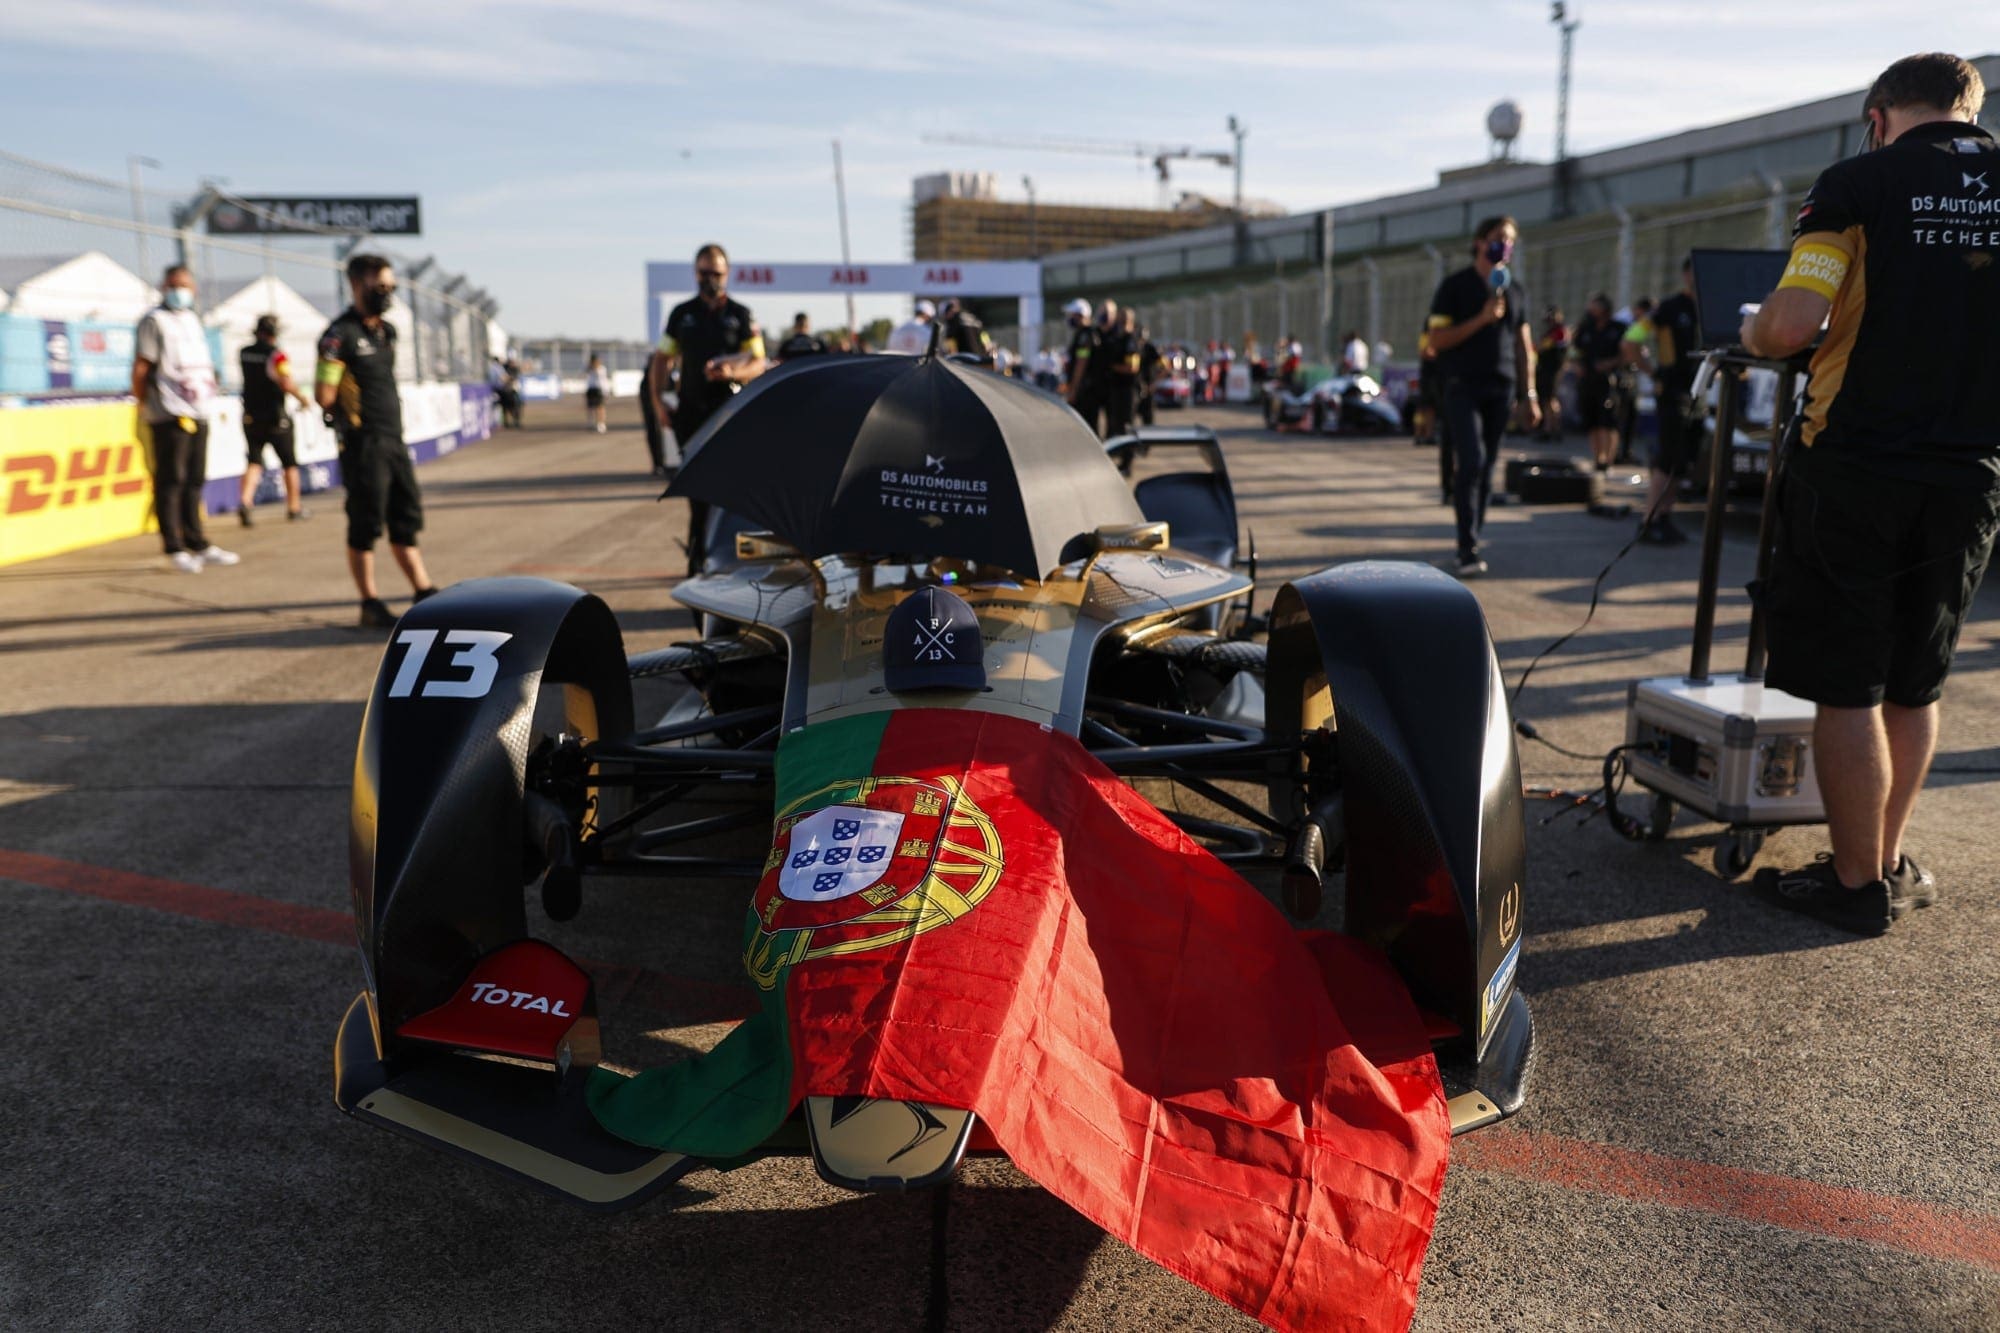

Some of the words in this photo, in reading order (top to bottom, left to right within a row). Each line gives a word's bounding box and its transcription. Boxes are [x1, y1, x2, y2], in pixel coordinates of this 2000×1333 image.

[1911, 196, 1934, 212] DS
[735, 266, 775, 284] ABB
[830, 266, 869, 284] ABB
[924, 266, 962, 284] ABB
[4, 445, 143, 515] DHL
[881, 470, 898, 483] DS
[901, 473, 988, 492] AUTOMOBILES
[880, 494, 987, 516] TECHEETAH
[913, 634, 922, 645] A
[945, 633, 954, 644] C
[388, 629, 513, 698] 13
[929, 649, 942, 660] 13
[470, 983, 571, 1018] TOTAL
